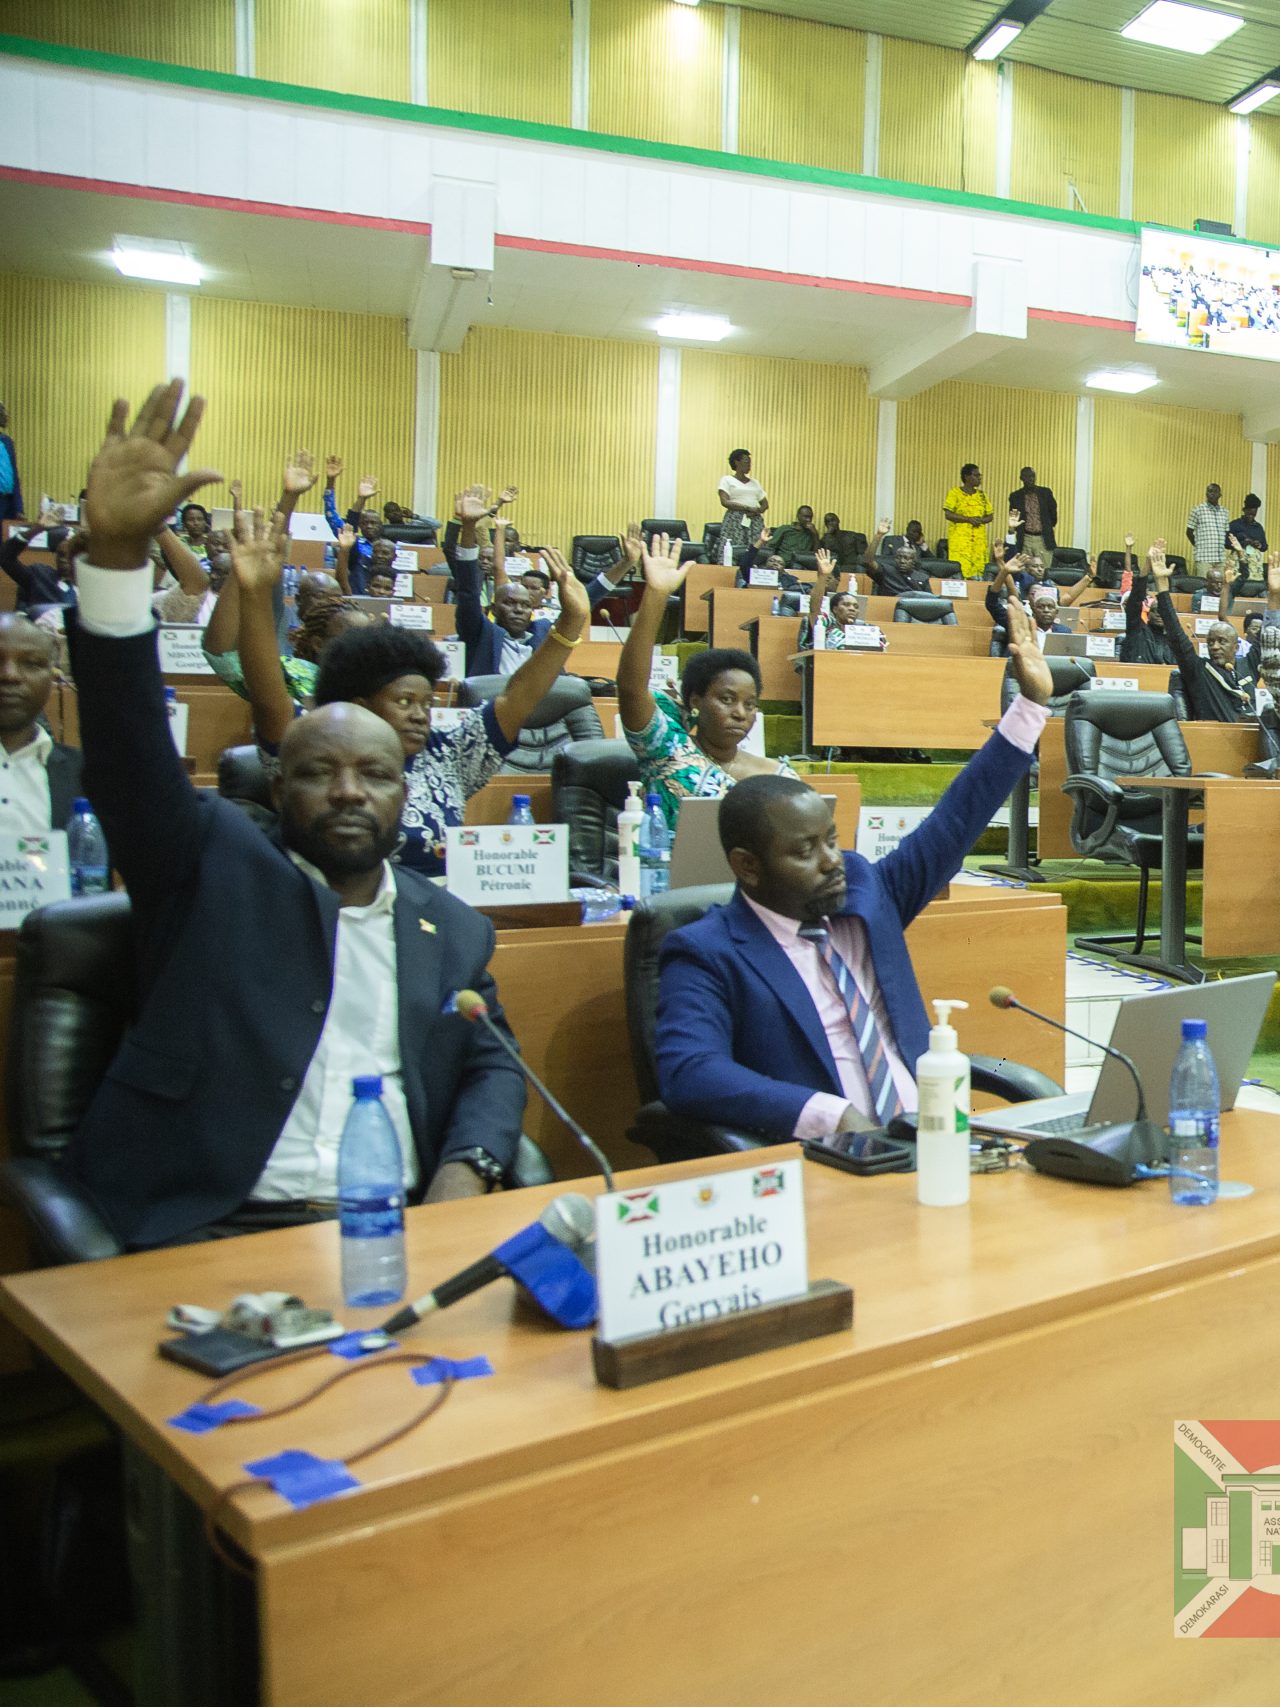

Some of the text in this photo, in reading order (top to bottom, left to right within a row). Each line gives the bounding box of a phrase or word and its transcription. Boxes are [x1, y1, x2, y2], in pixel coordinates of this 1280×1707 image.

[473, 849, 539, 861] Honorable
[476, 864, 536, 876] BUCUMI
[480, 879, 532, 891] Pétronie
[642, 1213, 768, 1258] Honorable
[629, 1241, 783, 1300] ABAYEHO
[658, 1283, 763, 1331] Gervais
